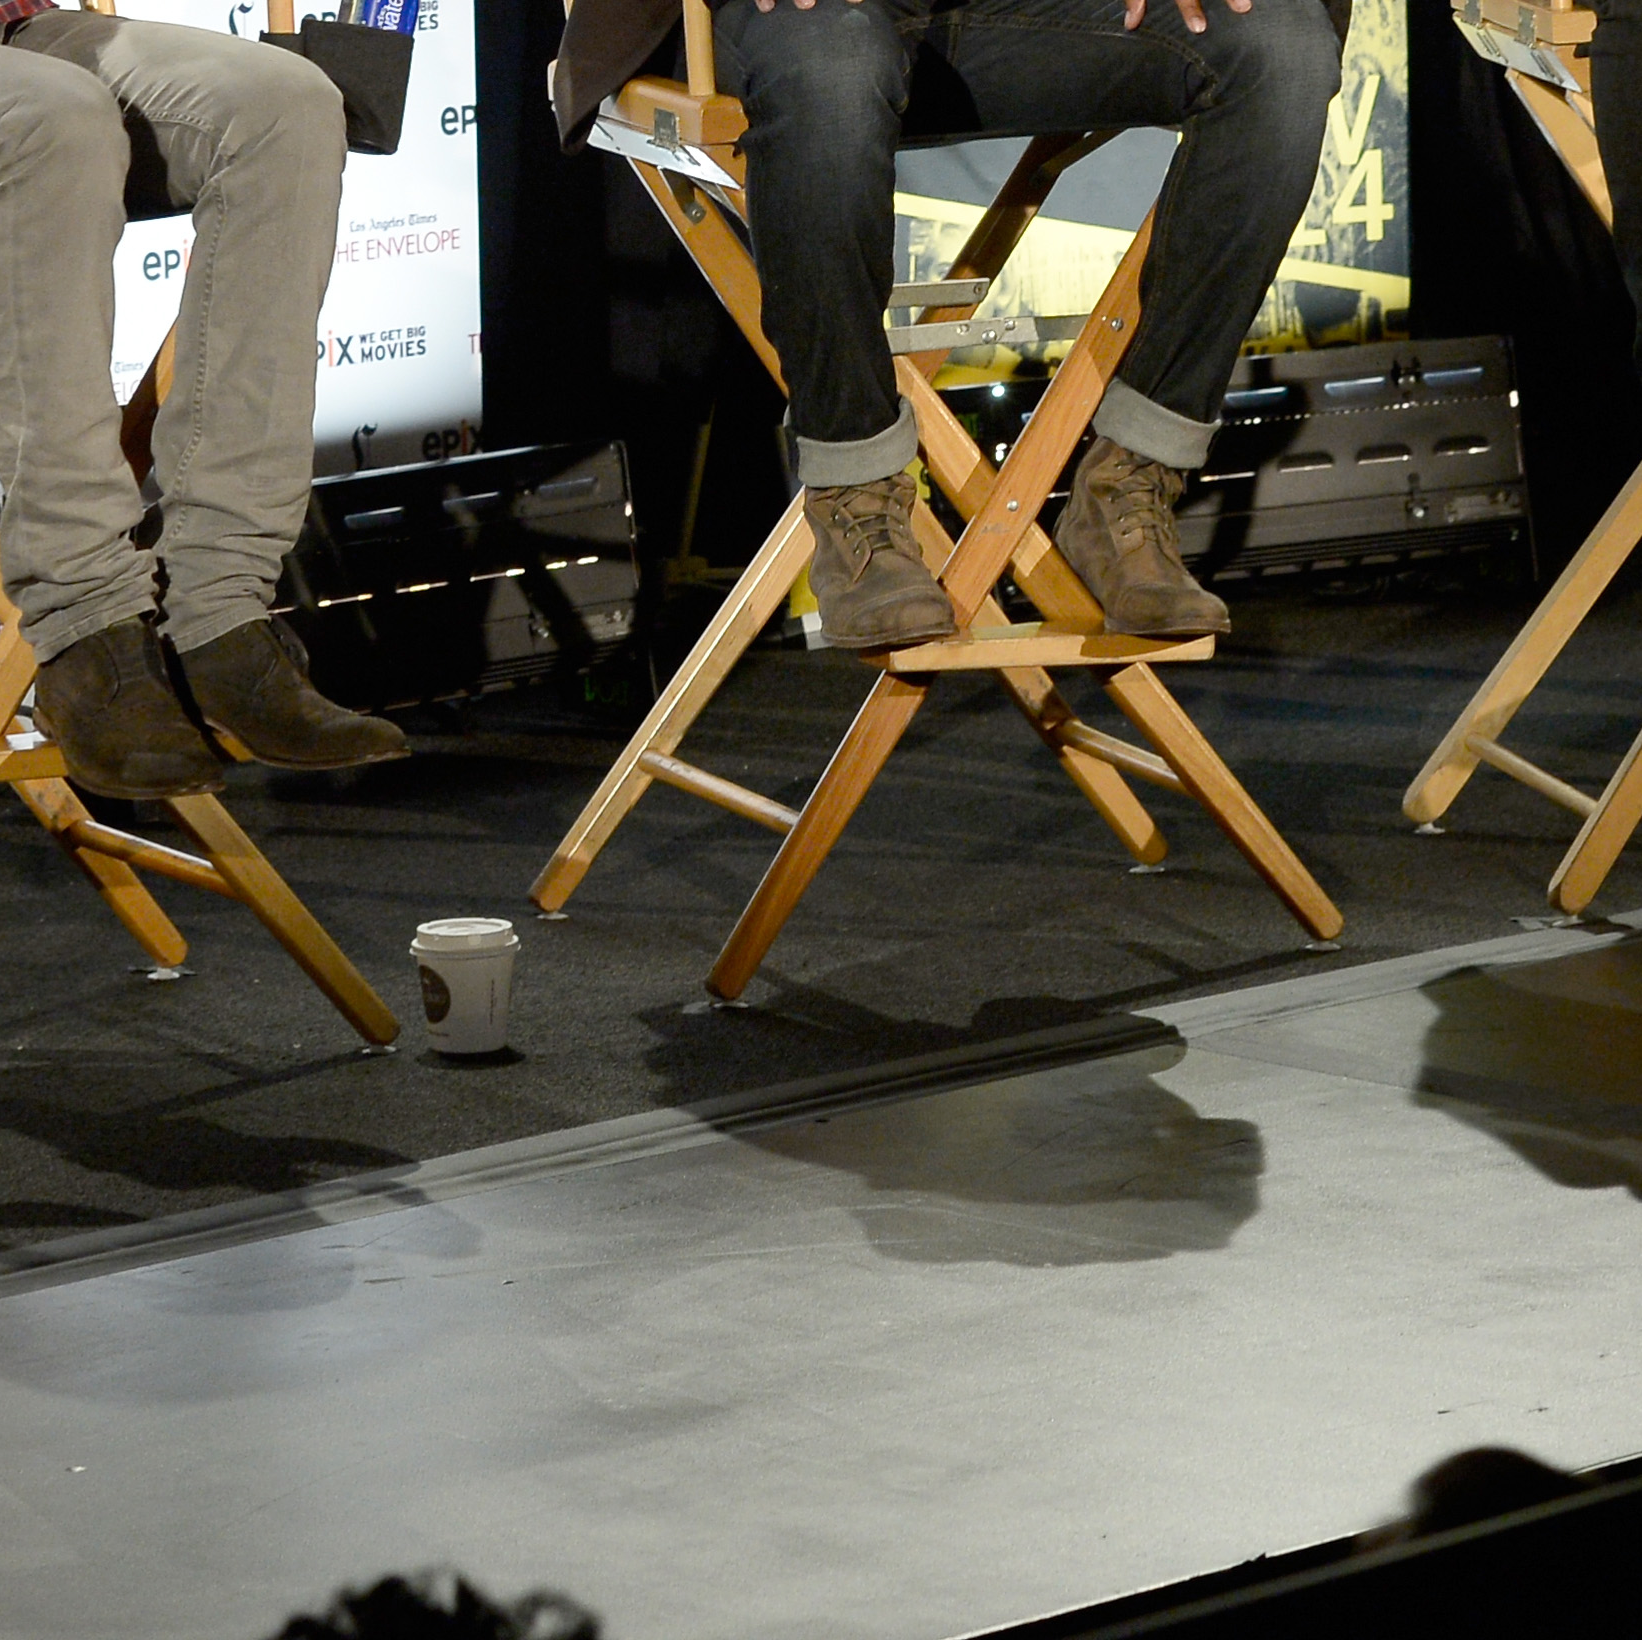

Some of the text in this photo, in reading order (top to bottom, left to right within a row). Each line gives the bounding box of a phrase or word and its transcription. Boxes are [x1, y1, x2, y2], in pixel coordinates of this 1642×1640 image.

[349, 213, 438, 233] Los Angeles Times
[366, 227, 461, 261] ENVELOPE
[358, 325, 427, 344] WE GET BIG
[360, 340, 427, 363] MOVIES
